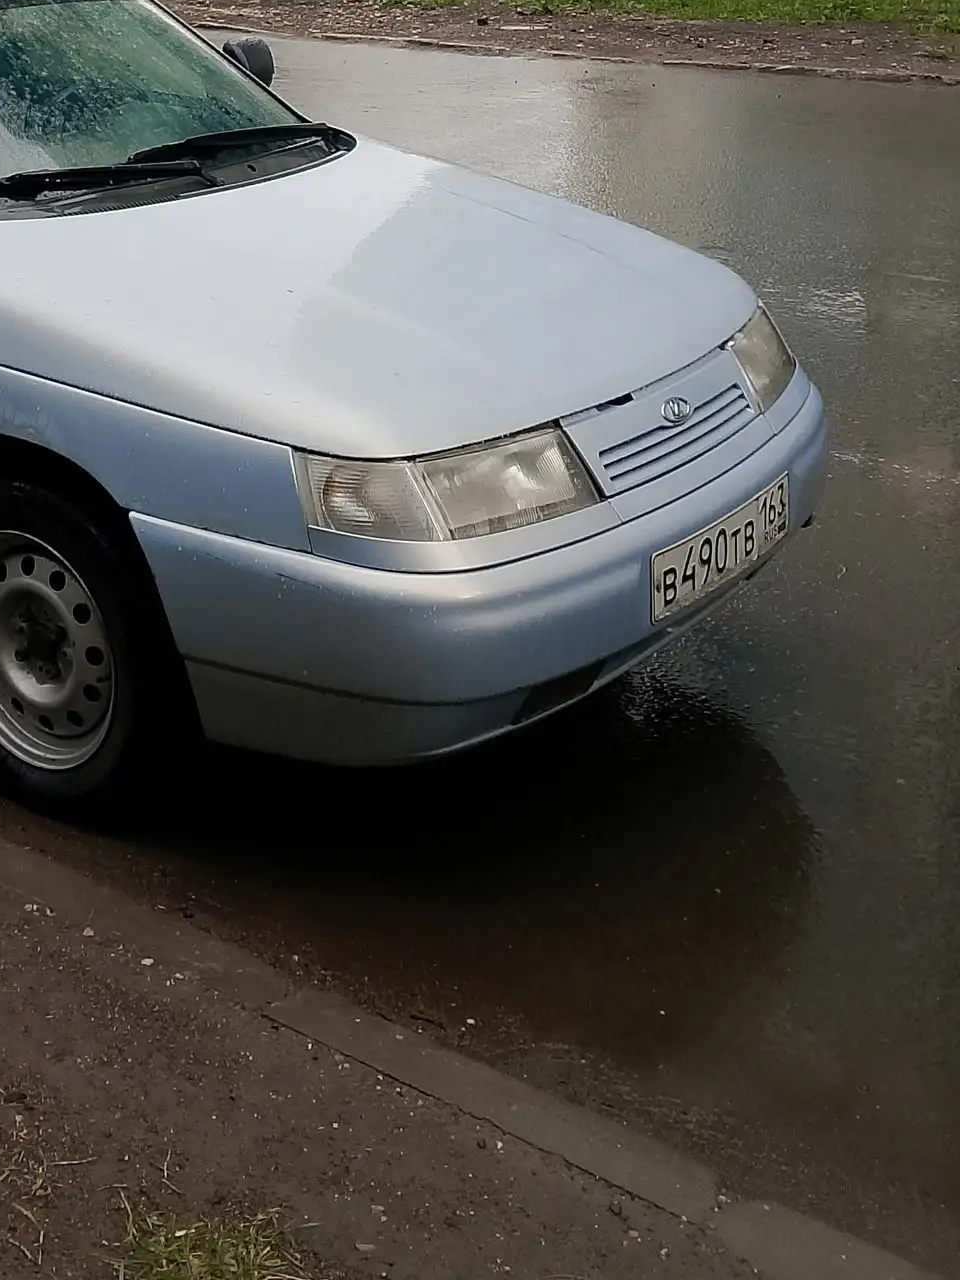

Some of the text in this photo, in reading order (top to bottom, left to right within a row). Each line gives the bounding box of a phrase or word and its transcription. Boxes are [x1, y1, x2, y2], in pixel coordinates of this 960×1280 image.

[662, 482, 786, 607] В490ТВ 163
[764, 524, 779, 544] RUS
